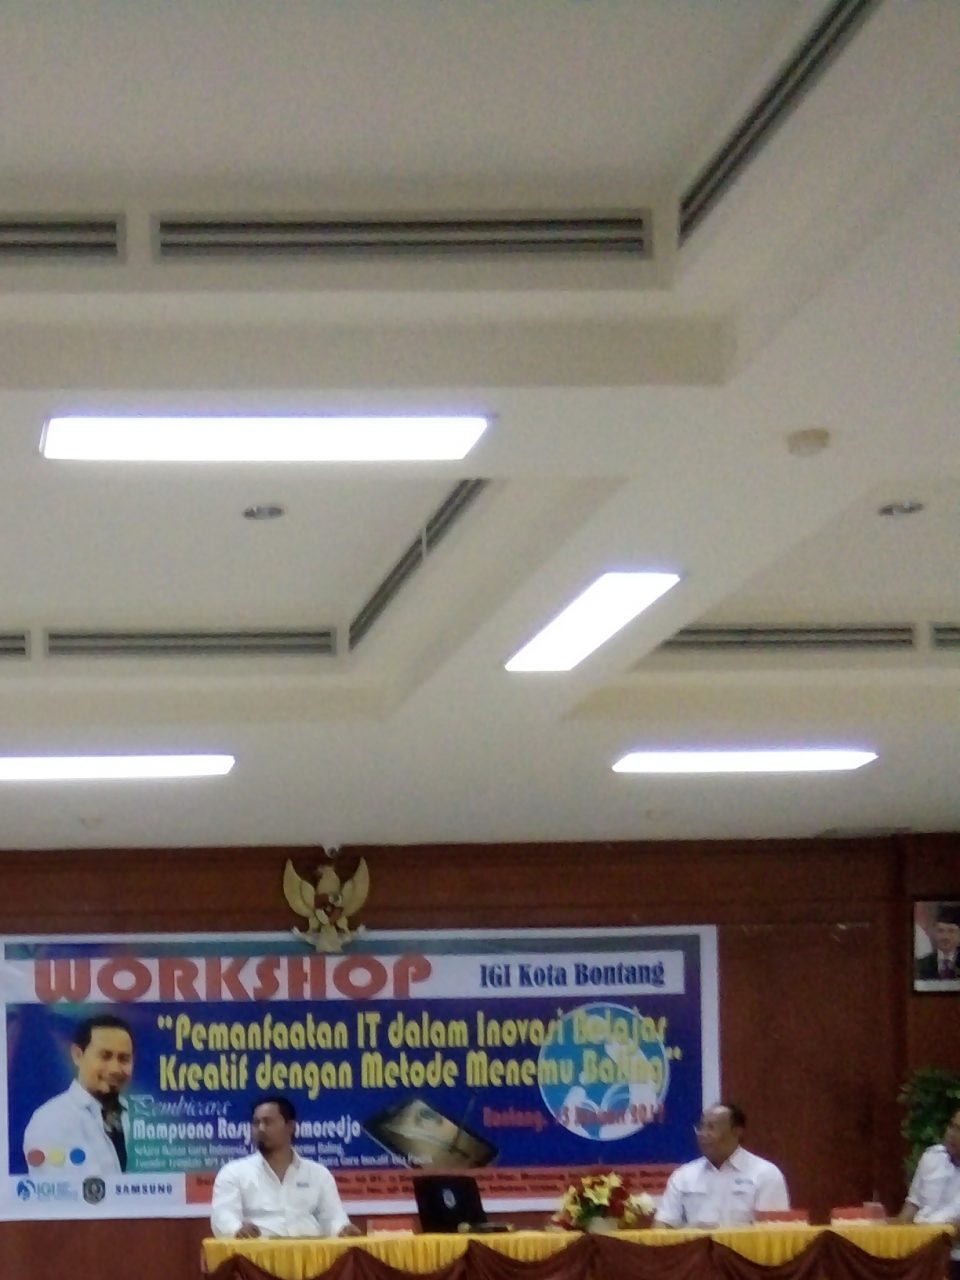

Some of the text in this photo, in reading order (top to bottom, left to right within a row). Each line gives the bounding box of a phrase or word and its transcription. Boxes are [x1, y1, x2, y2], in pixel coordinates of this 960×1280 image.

[34, 953, 432, 1004] WORKSHOP
[480, 961, 666, 988] IGI Kota Bontang
[357, 1011, 381, 1048] IT
[388, 1010, 469, 1048] dalam
[476, 1007, 564, 1047] Inovasi
[571, 1006, 668, 1049] Belajar
[158, 1052, 249, 1092] Kreatif
[255, 1053, 353, 1101] dengan
[361, 1051, 459, 1089] Metode
[466, 1049, 574, 1088] Menemu
[133, 1119, 214, 1144] Mampuono
[217, 1116, 252, 1146] Rasy
